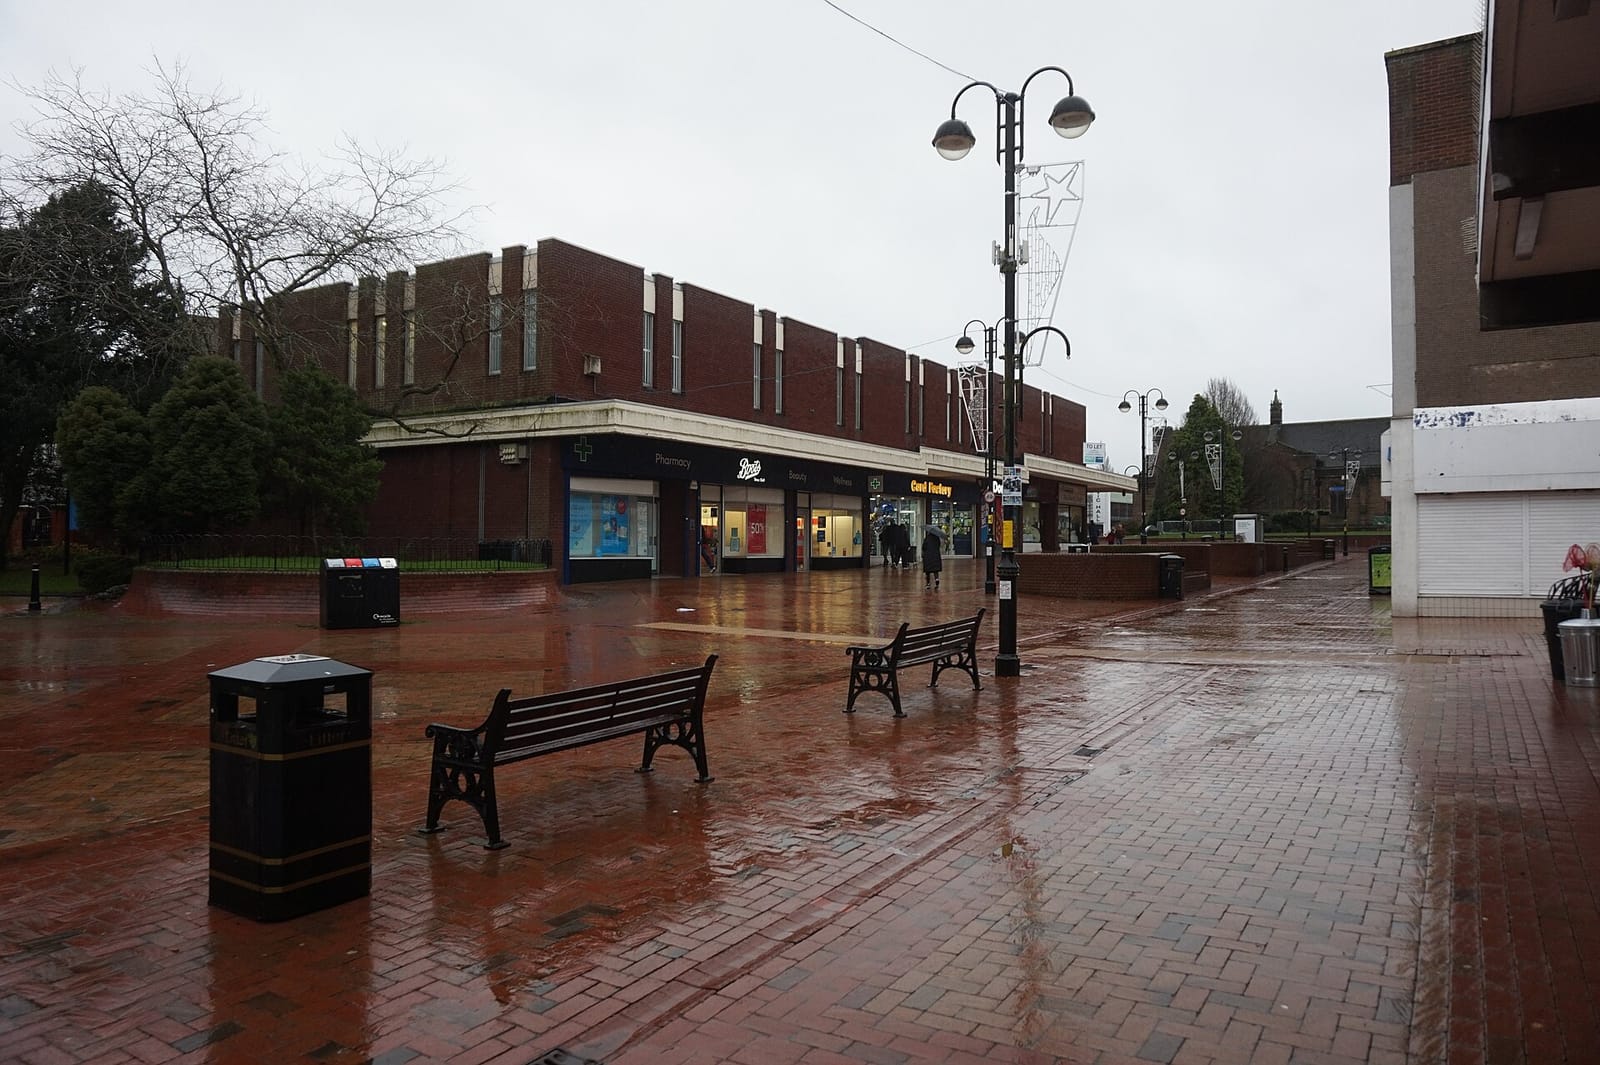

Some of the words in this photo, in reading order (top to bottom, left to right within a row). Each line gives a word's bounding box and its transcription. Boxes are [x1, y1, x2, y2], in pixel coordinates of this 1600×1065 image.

[655, 453, 691, 470] Pharmacy
[737, 457, 762, 480] Boots
[788, 470, 807, 484] Beauty
[910, 480, 927, 493] Card
[928, 481, 952, 498] Factory
[992, 480, 1003, 494] Do
